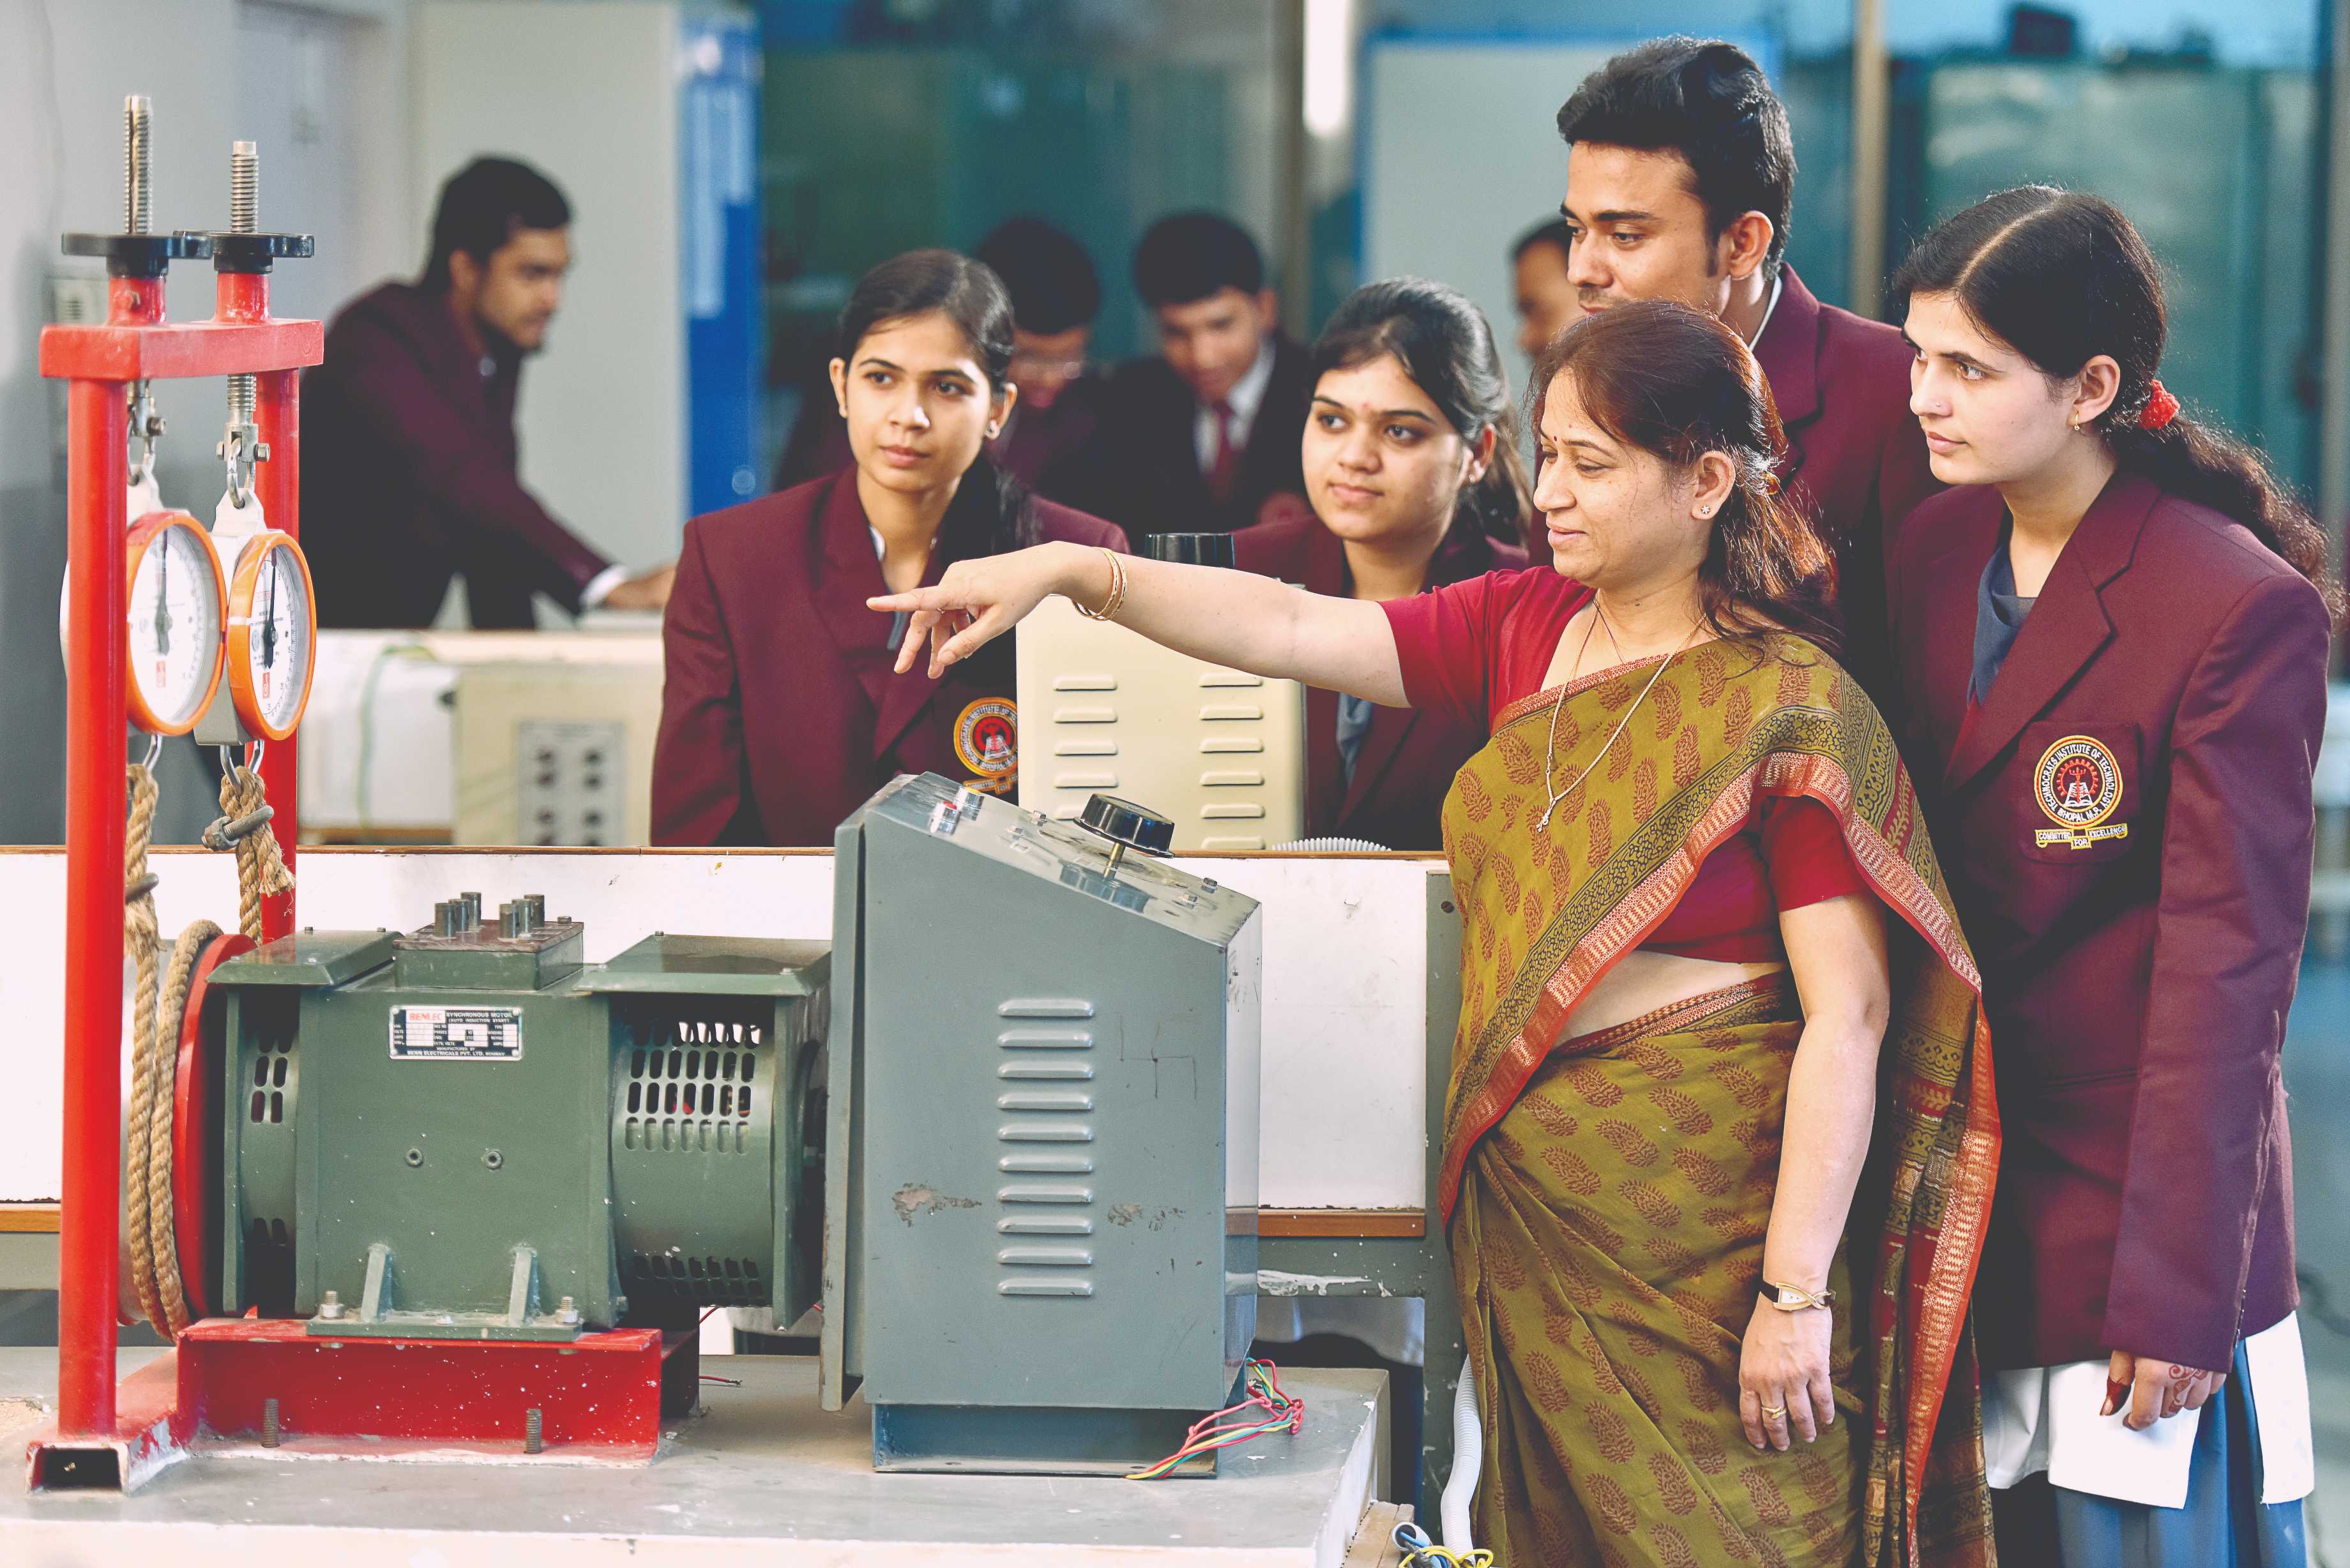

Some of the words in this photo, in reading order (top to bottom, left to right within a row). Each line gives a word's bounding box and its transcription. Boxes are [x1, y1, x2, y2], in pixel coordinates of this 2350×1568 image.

[2041, 757, 2058, 811] TECHNOCRATS
[2054, 744, 2091, 760] INSTITUTE
[2091, 749, 2102, 759] OF
[2099, 756, 2115, 809] TECHNOLOGY
[2057, 808, 2087, 822] BHOPAL
[2089, 825, 2126, 838] EXCELLENCE
[409, 1013, 441, 1021] BENLEC
